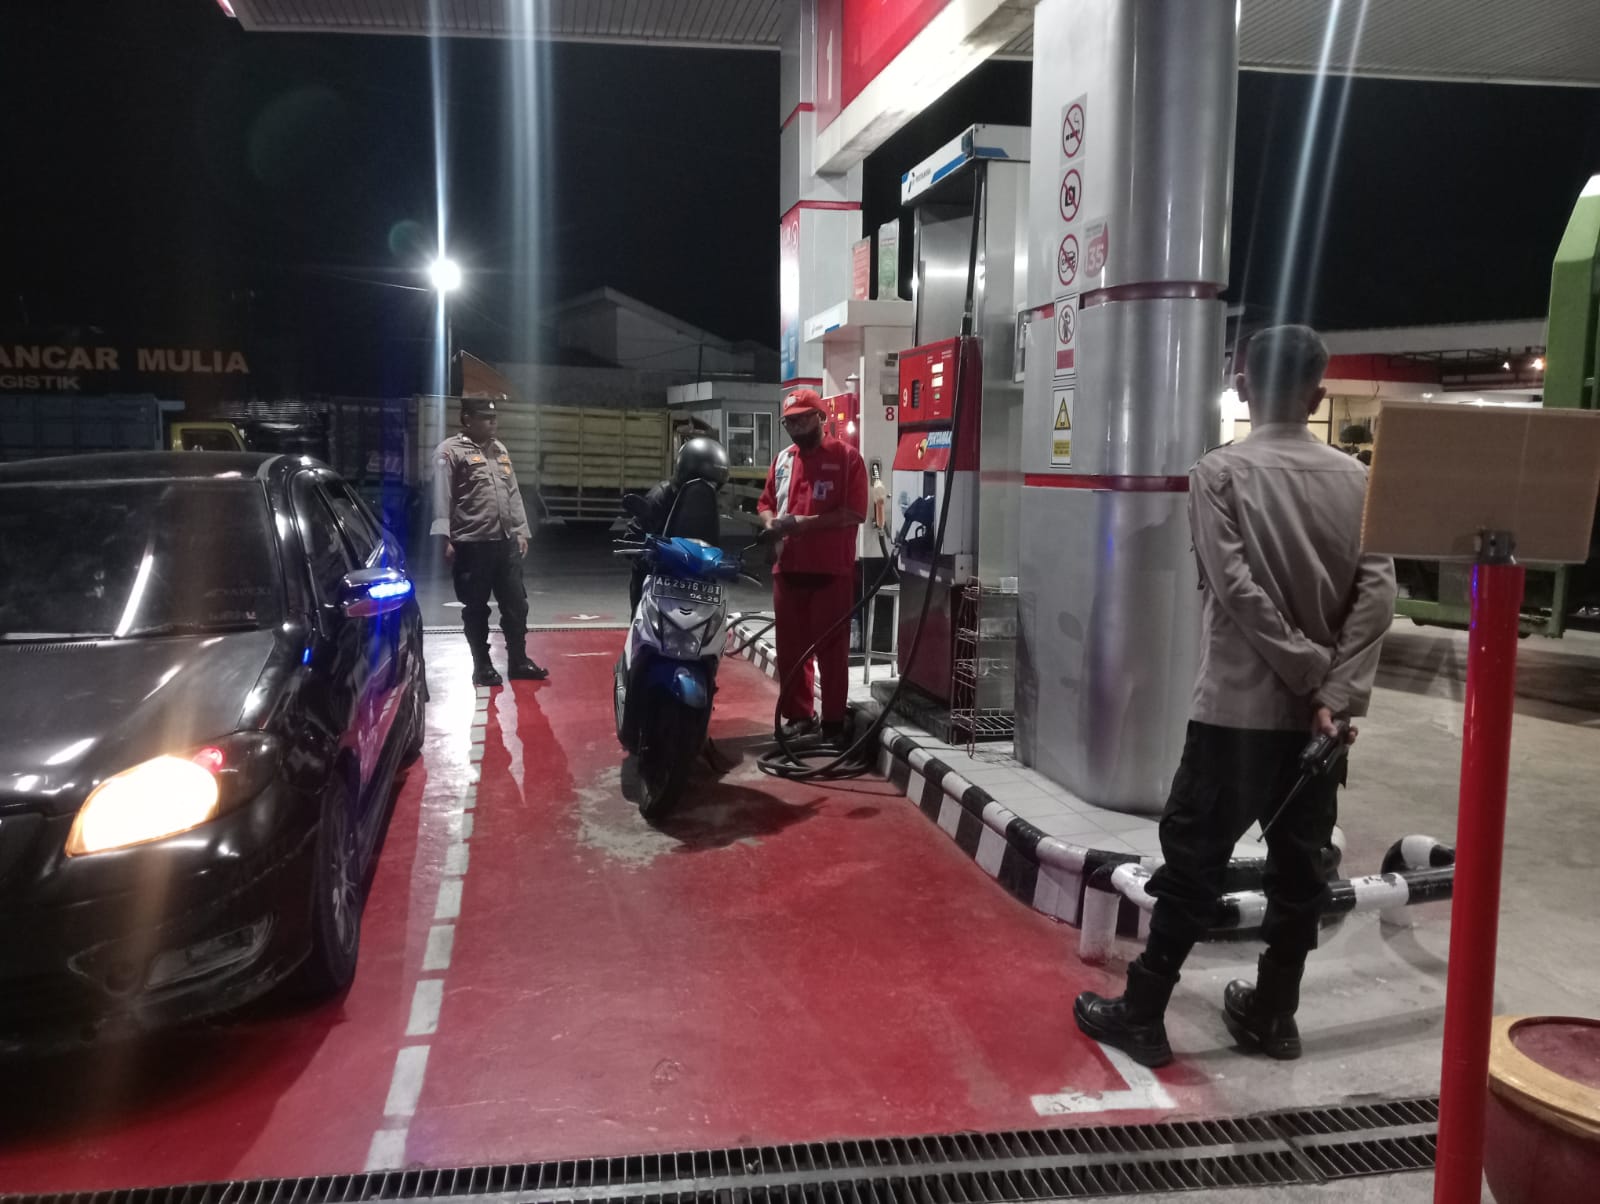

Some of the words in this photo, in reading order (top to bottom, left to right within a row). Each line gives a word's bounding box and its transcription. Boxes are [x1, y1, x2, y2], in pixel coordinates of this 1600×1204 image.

[137, 348, 250, 374] MULIA
[0, 375, 81, 391] GISTIK
[885, 407, 895, 421] 8
